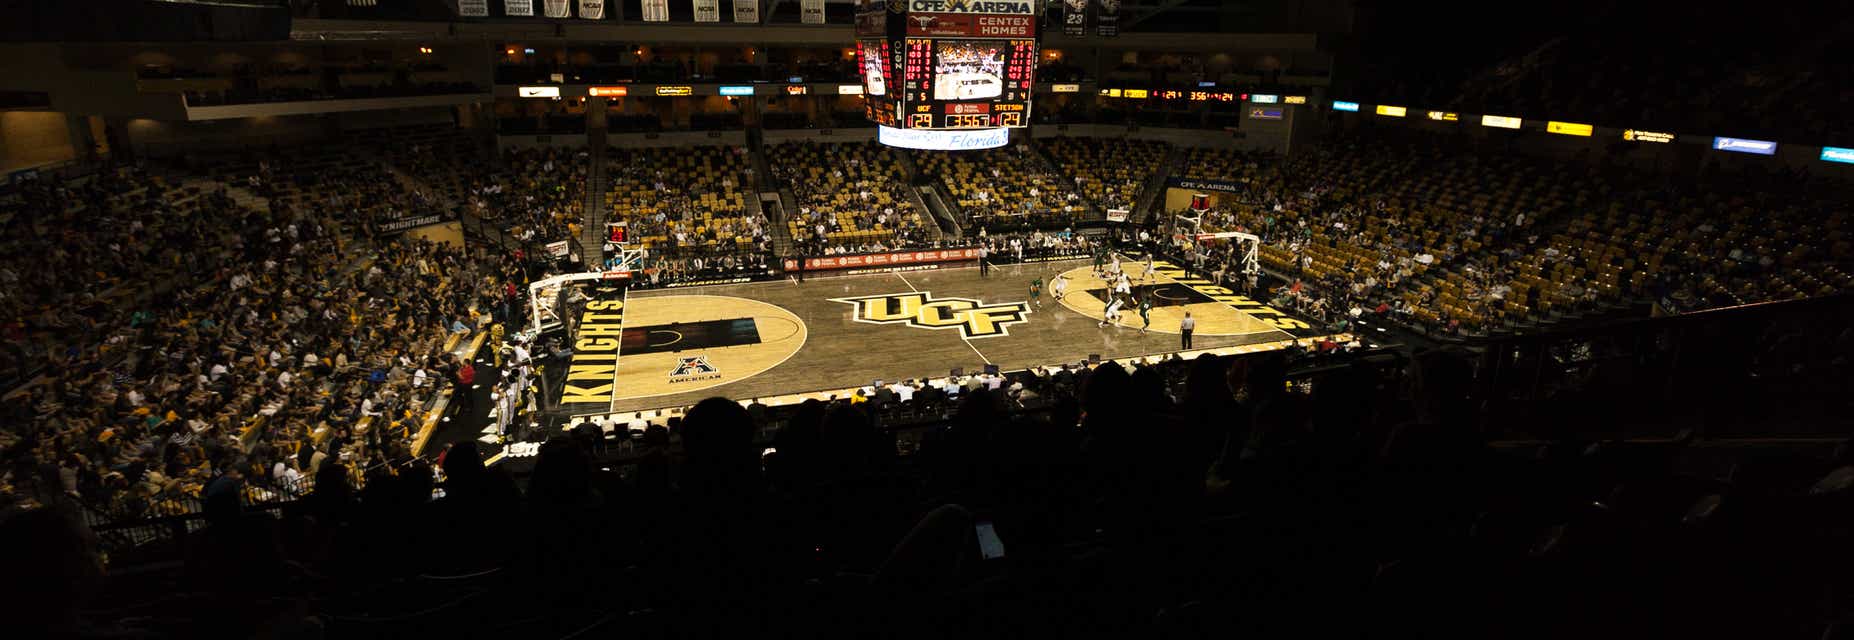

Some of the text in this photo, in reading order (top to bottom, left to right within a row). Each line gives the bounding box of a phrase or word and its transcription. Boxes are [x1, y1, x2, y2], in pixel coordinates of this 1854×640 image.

[912, 0, 1031, 13] CFE ARENA
[979, 17, 1030, 26] CENTEX
[1067, 14, 1083, 24] 23
[982, 26, 1026, 35] HOMES
[894, 40, 902, 69] zero
[916, 115, 930, 127] 29
[1004, 112, 1020, 126] 24
[838, 291, 1032, 340] UCF
[560, 300, 624, 404] KNIGHTS
[668, 375, 721, 384] AMERICAN
